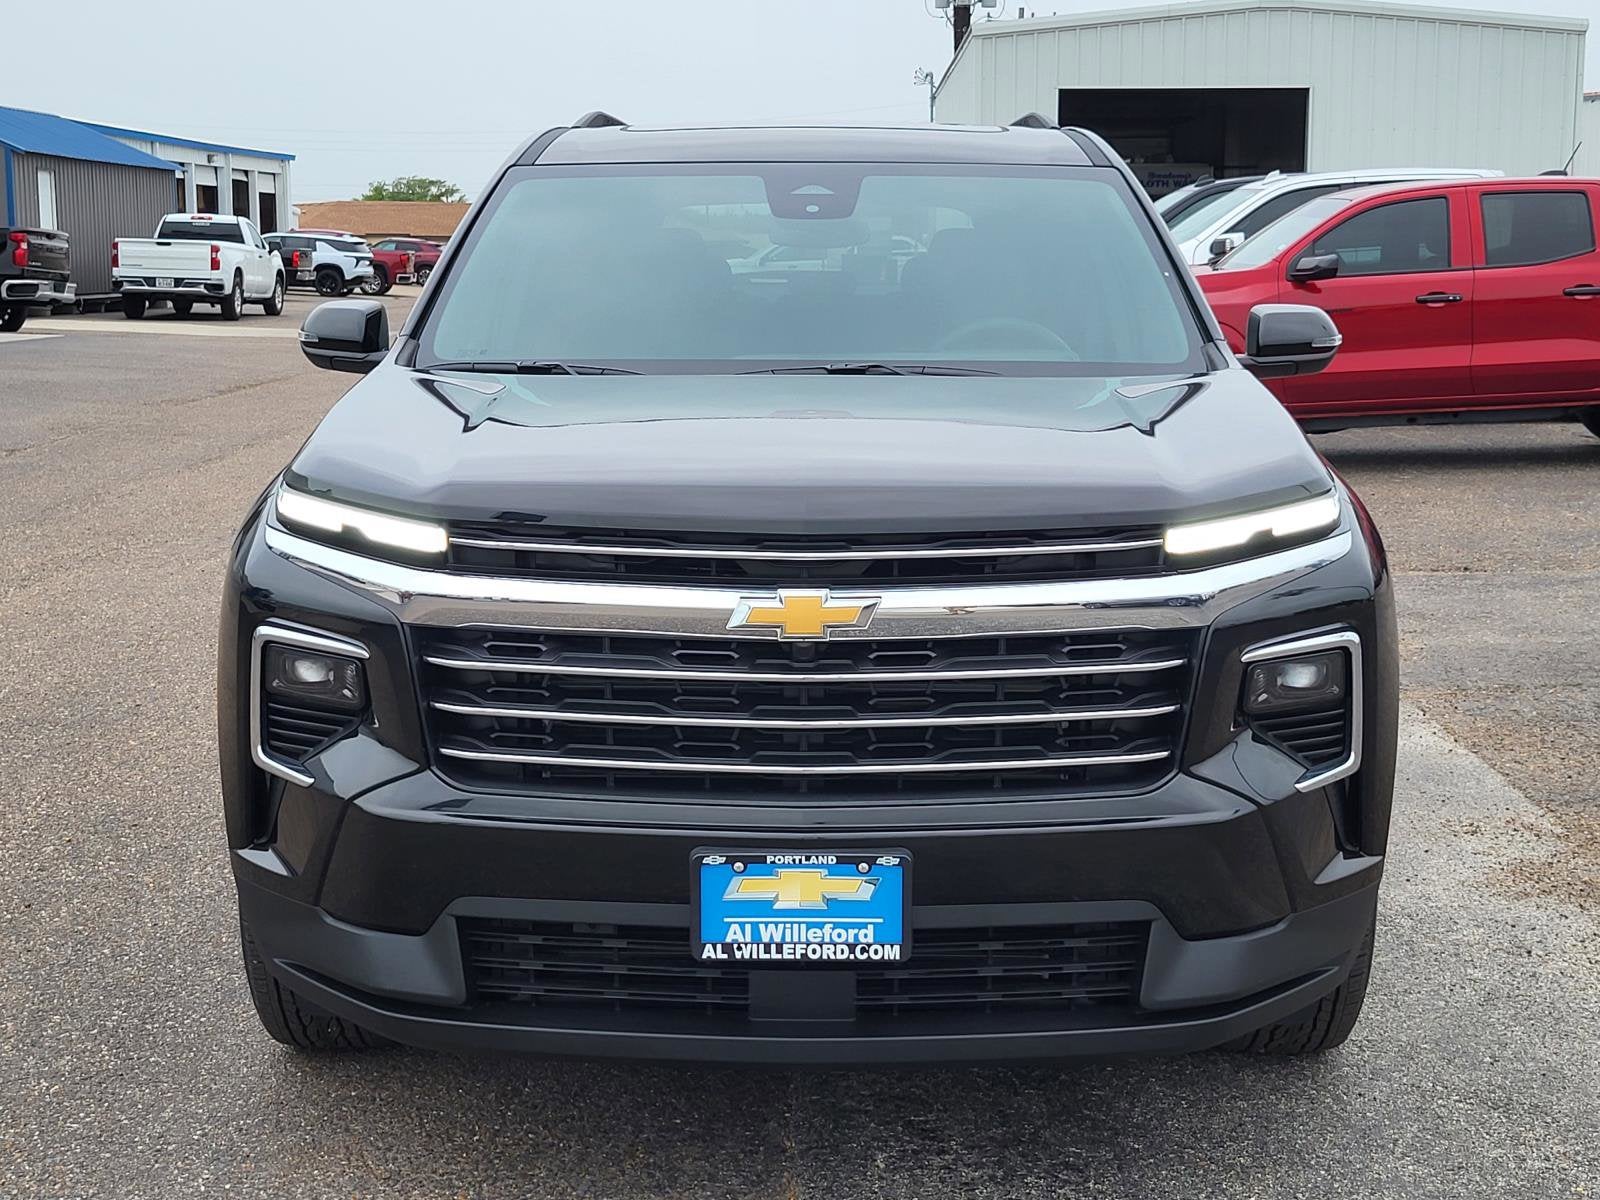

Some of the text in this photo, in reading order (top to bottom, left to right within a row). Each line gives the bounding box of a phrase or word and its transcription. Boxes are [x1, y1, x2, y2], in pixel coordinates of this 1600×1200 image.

[766, 855, 837, 865] PORTLAND
[725, 923, 874, 943] Al Willeford
[701, 943, 900, 960] AL WILLEFORD.COM
